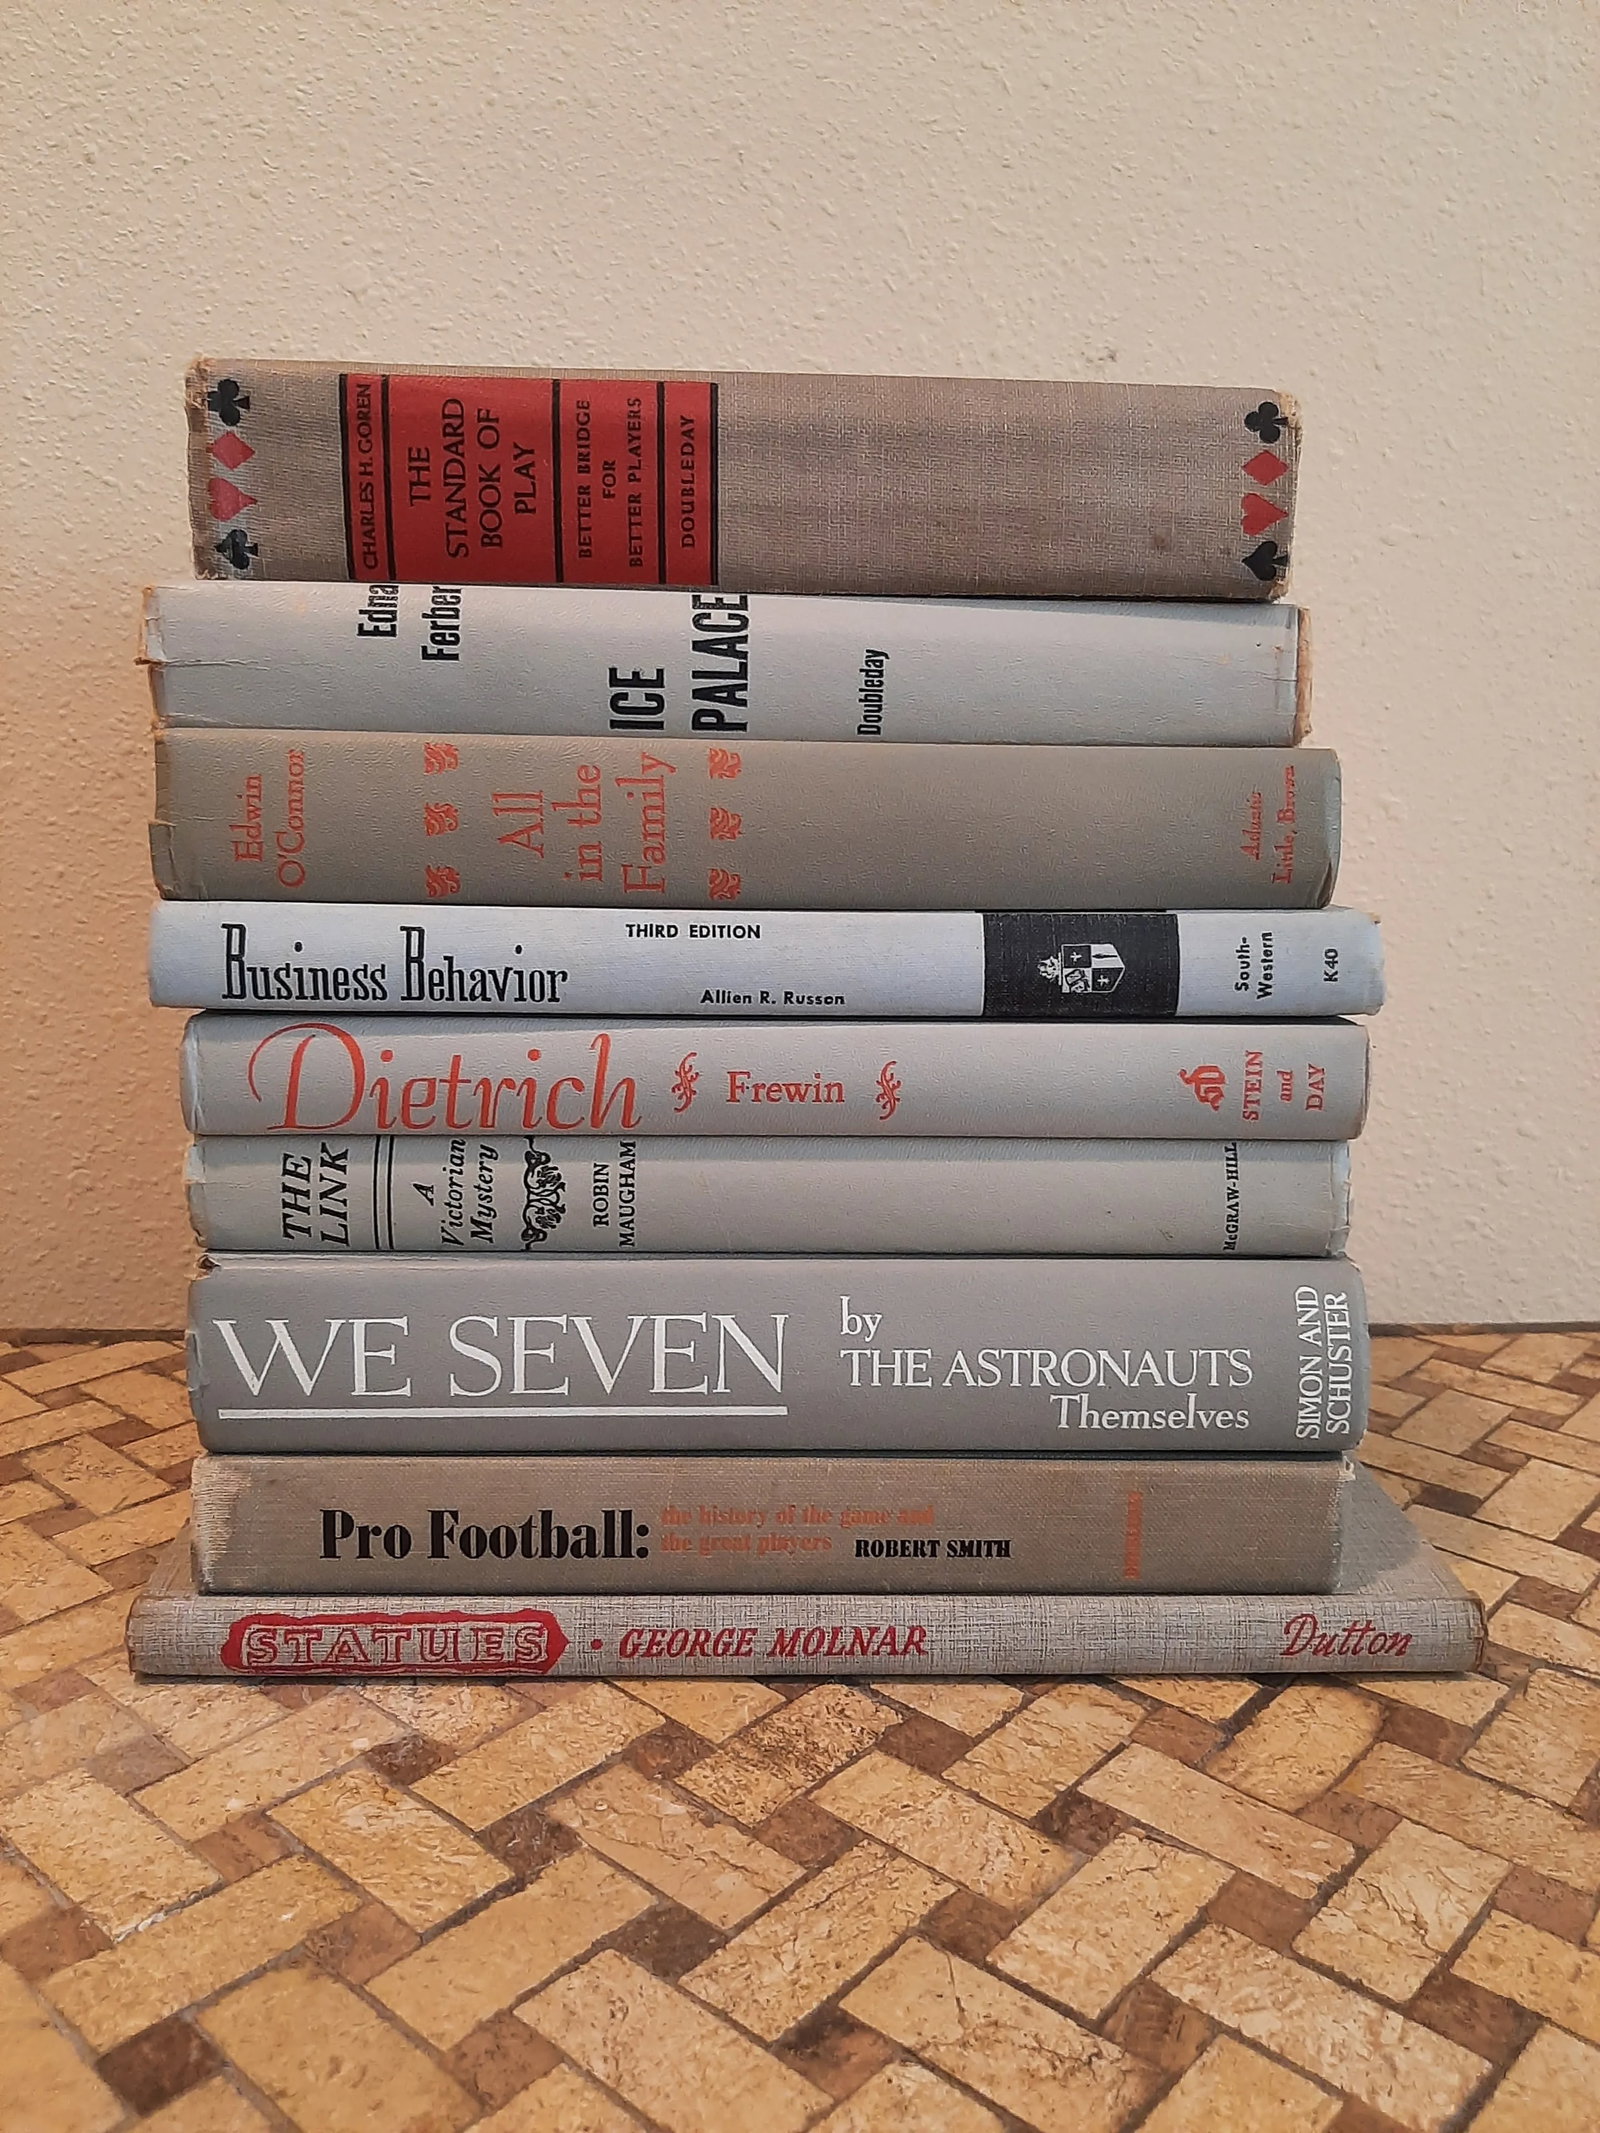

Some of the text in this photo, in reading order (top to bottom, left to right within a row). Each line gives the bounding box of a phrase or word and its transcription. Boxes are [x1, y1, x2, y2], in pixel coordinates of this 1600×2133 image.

[356, 384, 378, 570] CHARLES H. GOREN
[408, 447, 432, 506] THE
[441, 399, 470, 559] STANDARD
[477, 408, 502, 549] BOOK OF
[512, 442, 538, 516] PLAY
[576, 400, 593, 559] BETTER BRIDGE
[602, 459, 617, 500] FOR
[627, 397, 644, 568] BETTER PLAYERS
[680, 415, 696, 549] DOUBLEDAY
[357, 585, 399, 637] Edna
[421, 586, 461, 661] Ferber
[608, 667, 666, 730] ICE
[691, 594, 748, 732] PALACE
[857, 649, 889, 736] Doubleday
[228, 773, 263, 862] Edwin
[276, 749, 306, 887] O'Connor
[491, 790, 544, 858] All
[552, 764, 602, 882] in the
[614, 751, 676, 894] Family
[221, 923, 568, 1003] Business Behavior
[625, 923, 761, 939] THIRD EDITION
[1234, 936, 1251, 992] South-
[1256, 931, 1274, 1000] Western
[1323, 948, 1340, 983] K40
[700, 989, 845, 1006] Allien R. Russon
[247, 1022, 642, 1131] Dietrich
[726, 1070, 845, 1103] Frewin
[1242, 1050, 1263, 1121] STEIN
[1276, 1070, 1293, 1102] and
[1305, 1063, 1325, 1111] DAY
[281, 1153, 313, 1239] THE
[320, 1142, 350, 1246] LINK
[413, 1182, 434, 1206] A
[441, 1138, 466, 1246] Victorian
[470, 1144, 499, 1244] Mystery
[593, 1162, 611, 1228] ROBIN
[618, 1140, 636, 1248] MAUGHAM
[1224, 1143, 1240, 1251] McGRAW-HILL
[839, 1296, 883, 1342] by
[211, 1313, 790, 1397] WE SEVEN
[840, 1348, 1254, 1388] THE ASTRONAUTS
[1294, 1285, 1321, 1440] SIMON AND
[1324, 1291, 1352, 1435] SCHUSTER
[1050, 1393, 1250, 1430] Themselves
[319, 1508, 650, 1560] Pro Football:
[660, 1504, 935, 1529] the history of the game and
[660, 1533, 833, 1557] the great players
[855, 1538, 1012, 1559] ROBERT SMITH
[246, 1626, 548, 1664] STATUES
[619, 1625, 927, 1657] GEORGE MOLNAR
[1280, 1613, 1413, 1656] Dutton
